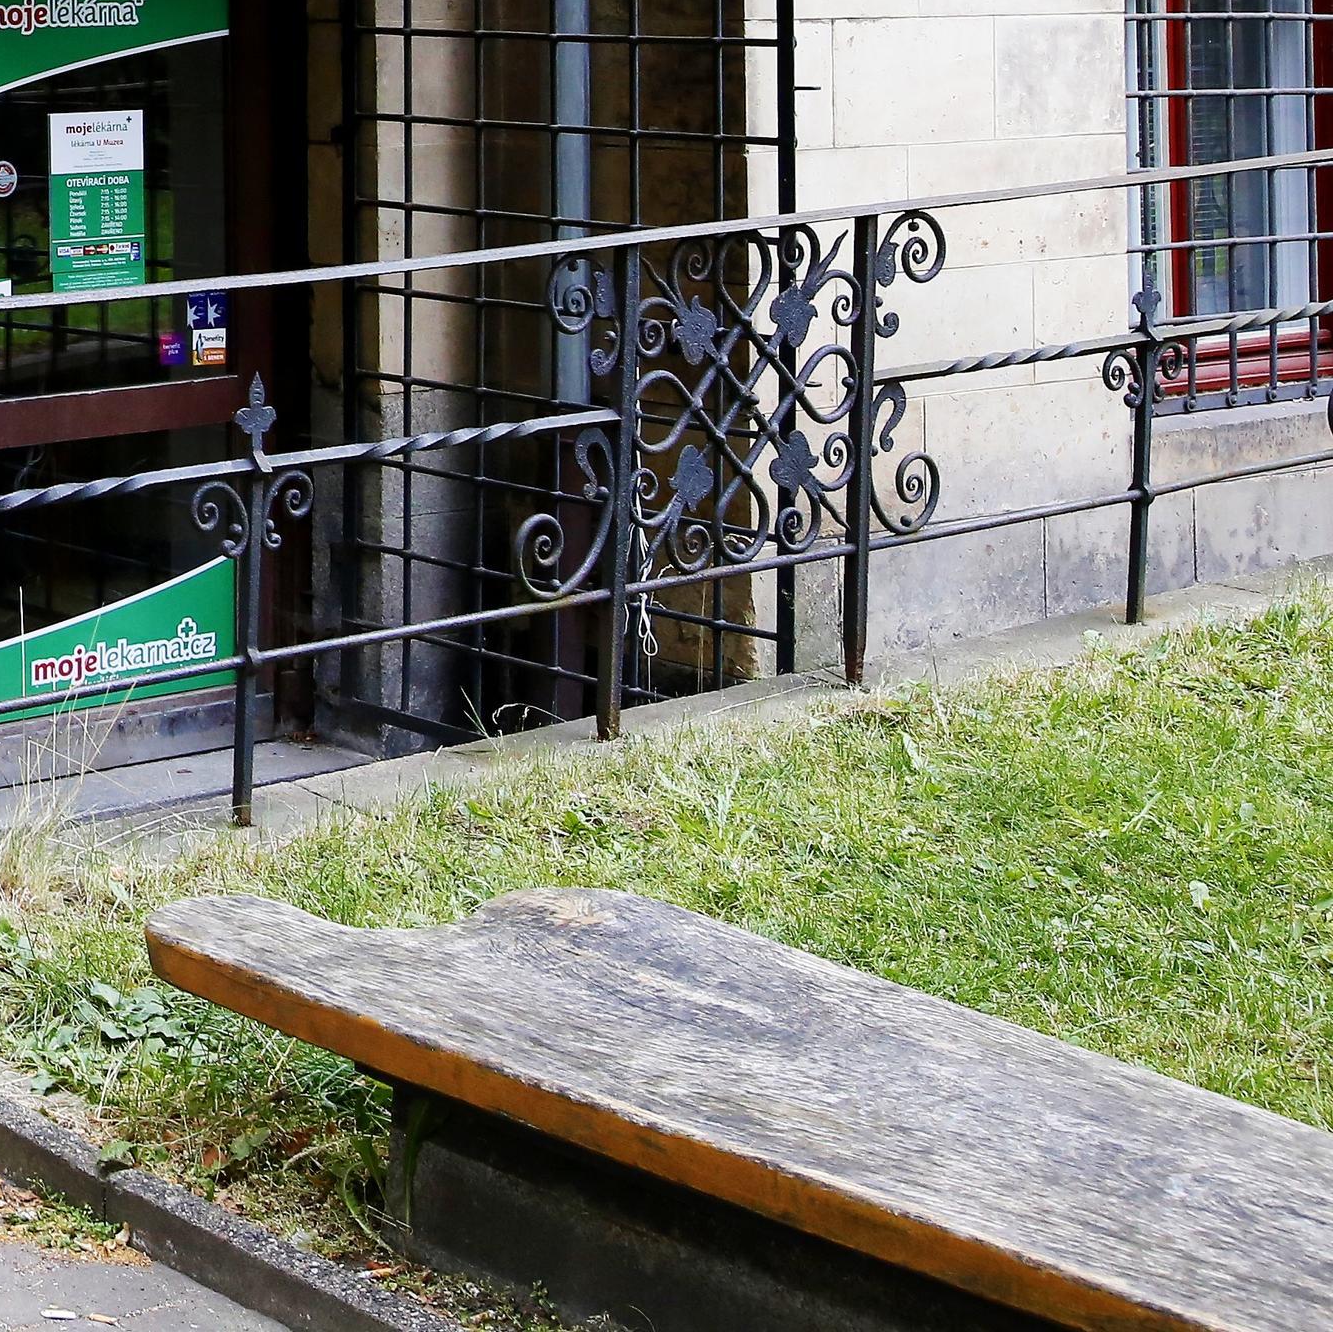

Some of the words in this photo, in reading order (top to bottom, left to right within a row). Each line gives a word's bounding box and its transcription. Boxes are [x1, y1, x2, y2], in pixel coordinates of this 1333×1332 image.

[65, 121, 128, 136] mojelékárna
[66, 175, 106, 187] OTEVÍRACÍ
[107, 175, 130, 185] DOBA
[34, 634, 213, 682] mojelekarna.cz
